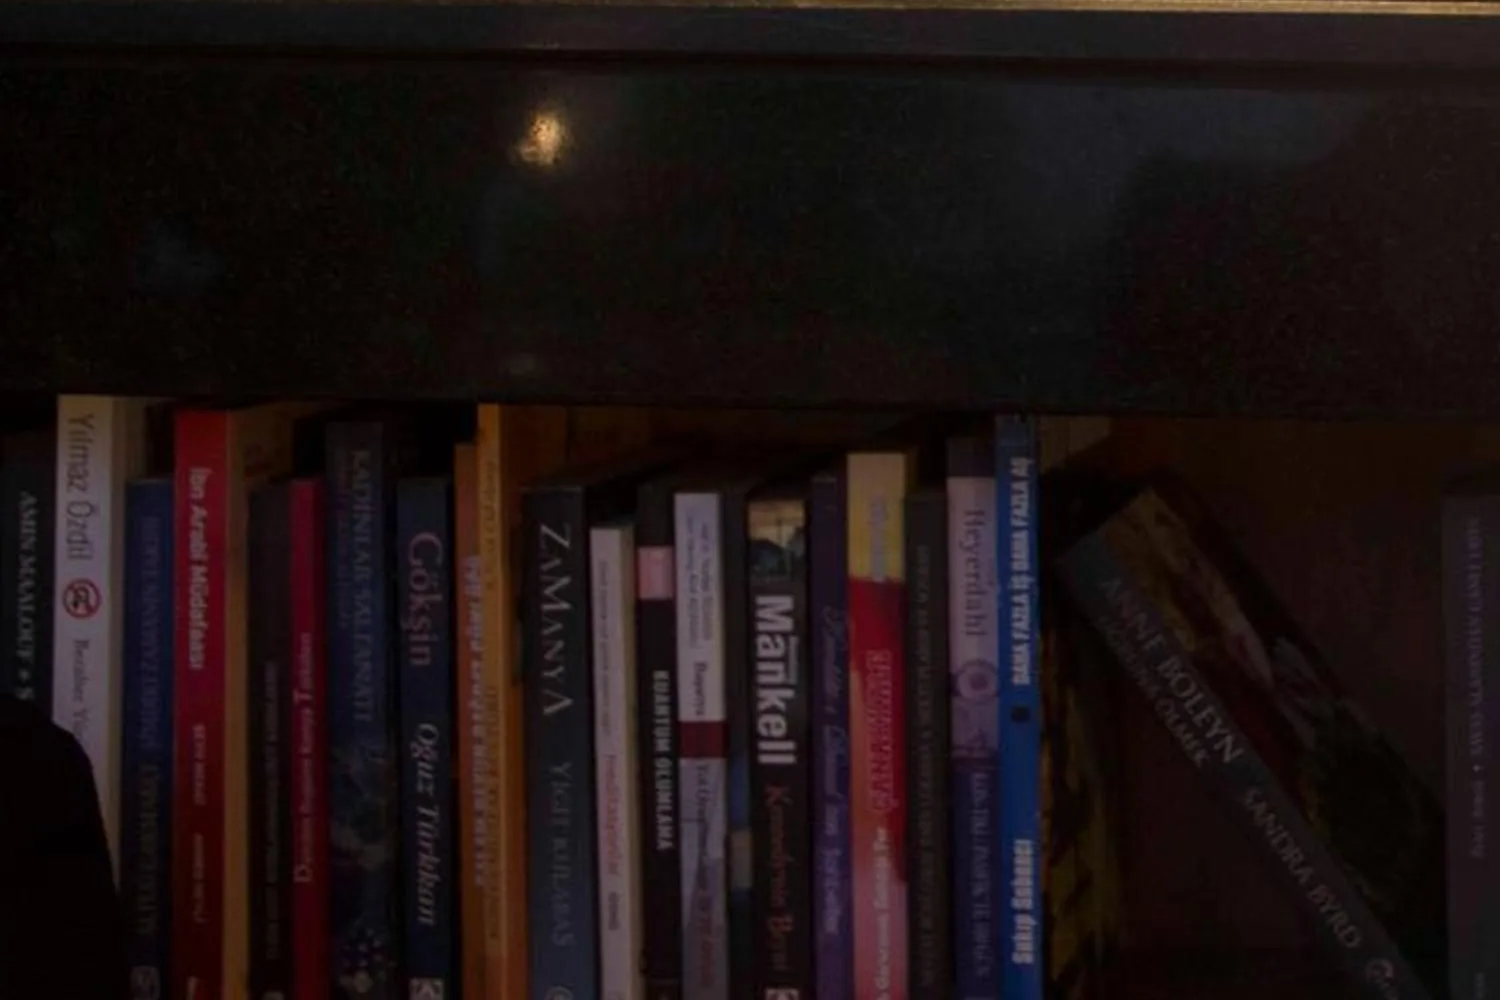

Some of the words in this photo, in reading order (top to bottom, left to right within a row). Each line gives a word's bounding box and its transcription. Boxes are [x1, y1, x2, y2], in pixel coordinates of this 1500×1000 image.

[67, 413, 94, 494] Yılmaz
[67, 499, 97, 561] Özdil
[958, 509, 989, 637] Heyerdahl
[399, 531, 444, 667] Gökşin
[651, 669, 672, 753] KUANTUM
[754, 593, 799, 766] Mankell
[1155, 652, 1245, 766] BOLEYN
[410, 722, 442, 797] Oğuz
[415, 802, 443, 927] Türkkan
[1238, 785, 1316, 886] SANDRA
